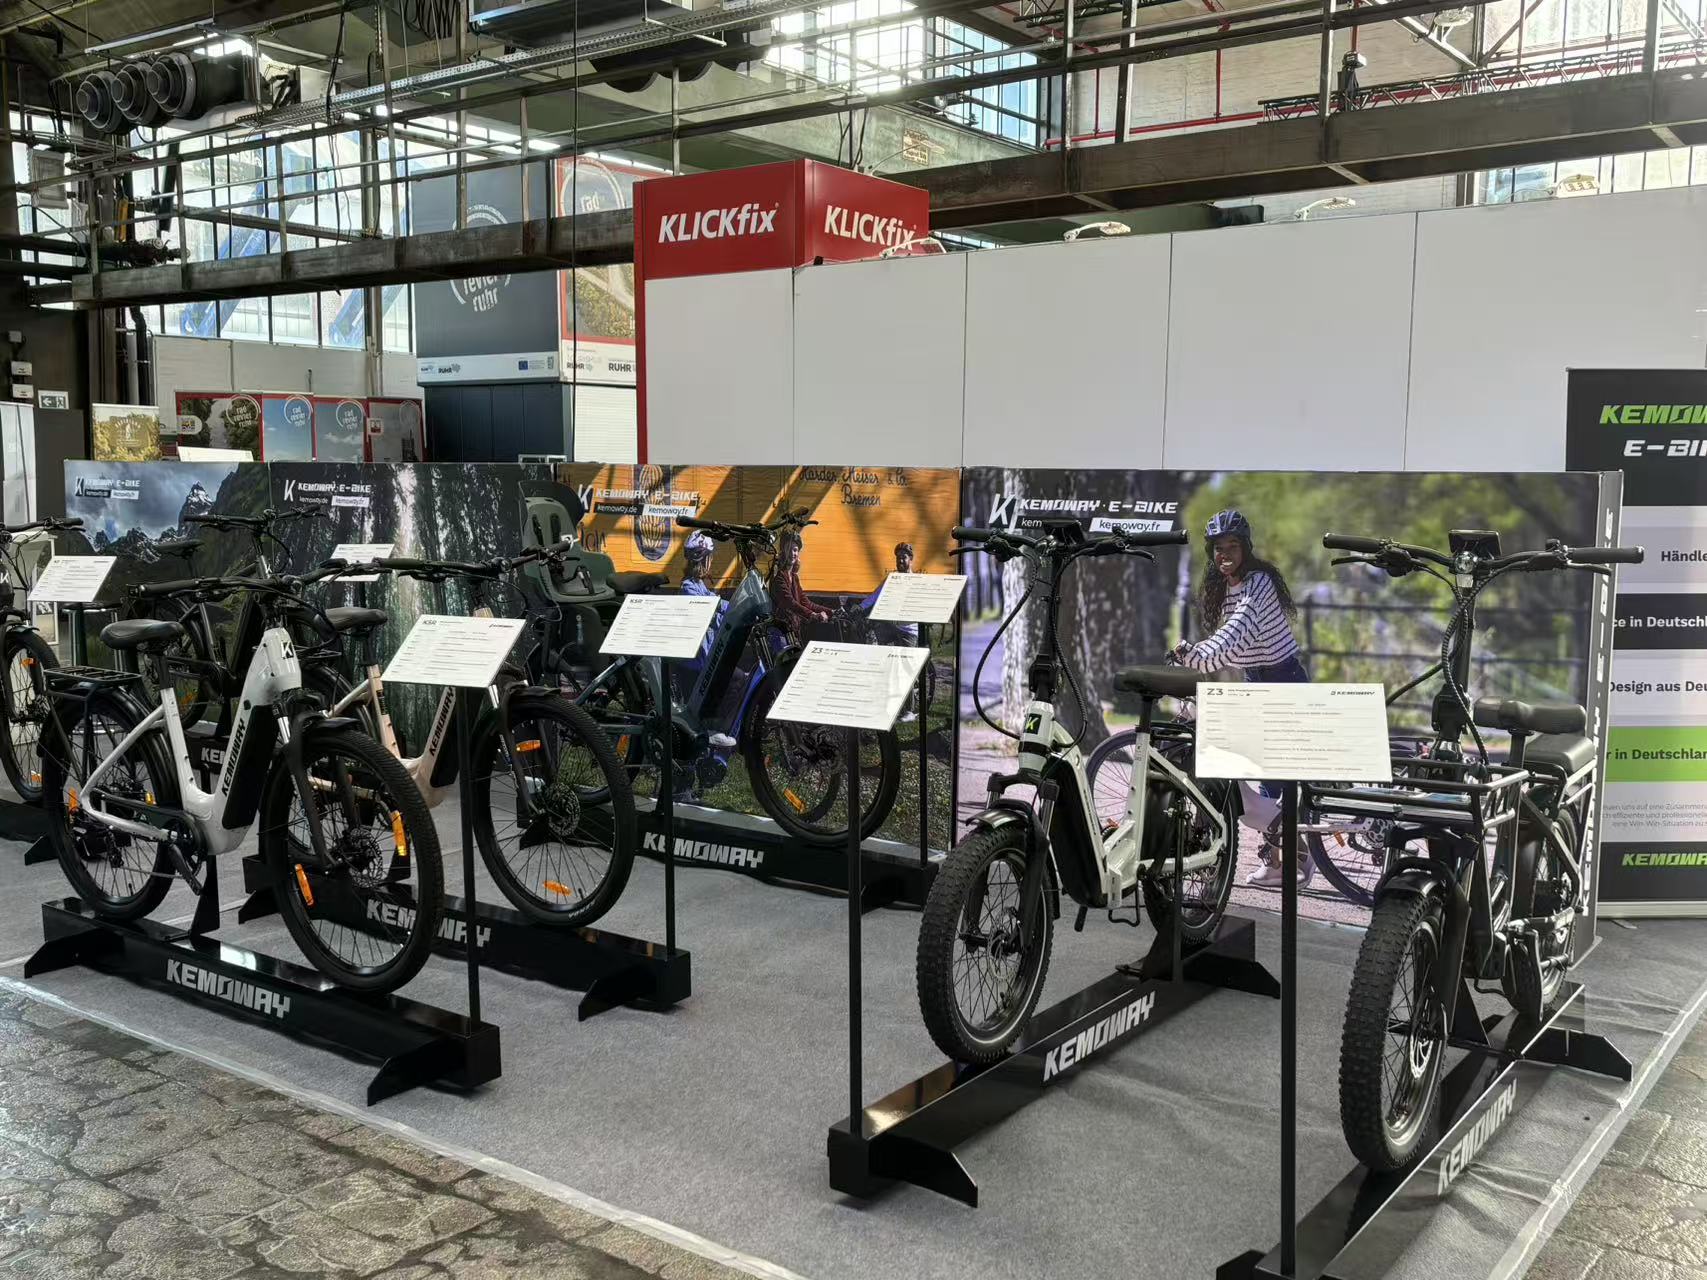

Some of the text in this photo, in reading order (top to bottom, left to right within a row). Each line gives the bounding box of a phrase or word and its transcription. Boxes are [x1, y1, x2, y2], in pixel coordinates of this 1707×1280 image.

[581, 191, 600, 213] rad
[473, 287, 498, 312] ruhr
[608, 362, 632, 372] RUHR
[298, 482, 372, 493] KEMOWAY E-BIKE
[595, 488, 649, 499] KEMOWAY
[1020, 498, 1179, 514] KEMOWAY E-BIKE
[1630, 615, 1643, 628] in
[1206, 687, 1224, 696] Z3
[1655, 682, 1681, 692] aus
[221, 718, 246, 797] KEMOWAY
[1615, 748, 1628, 760] in
[166, 958, 291, 1019] KEMOWAY
[1043, 988, 1156, 1082] KEMOWAY
[1438, 1077, 1517, 1196] KEMOWAY
